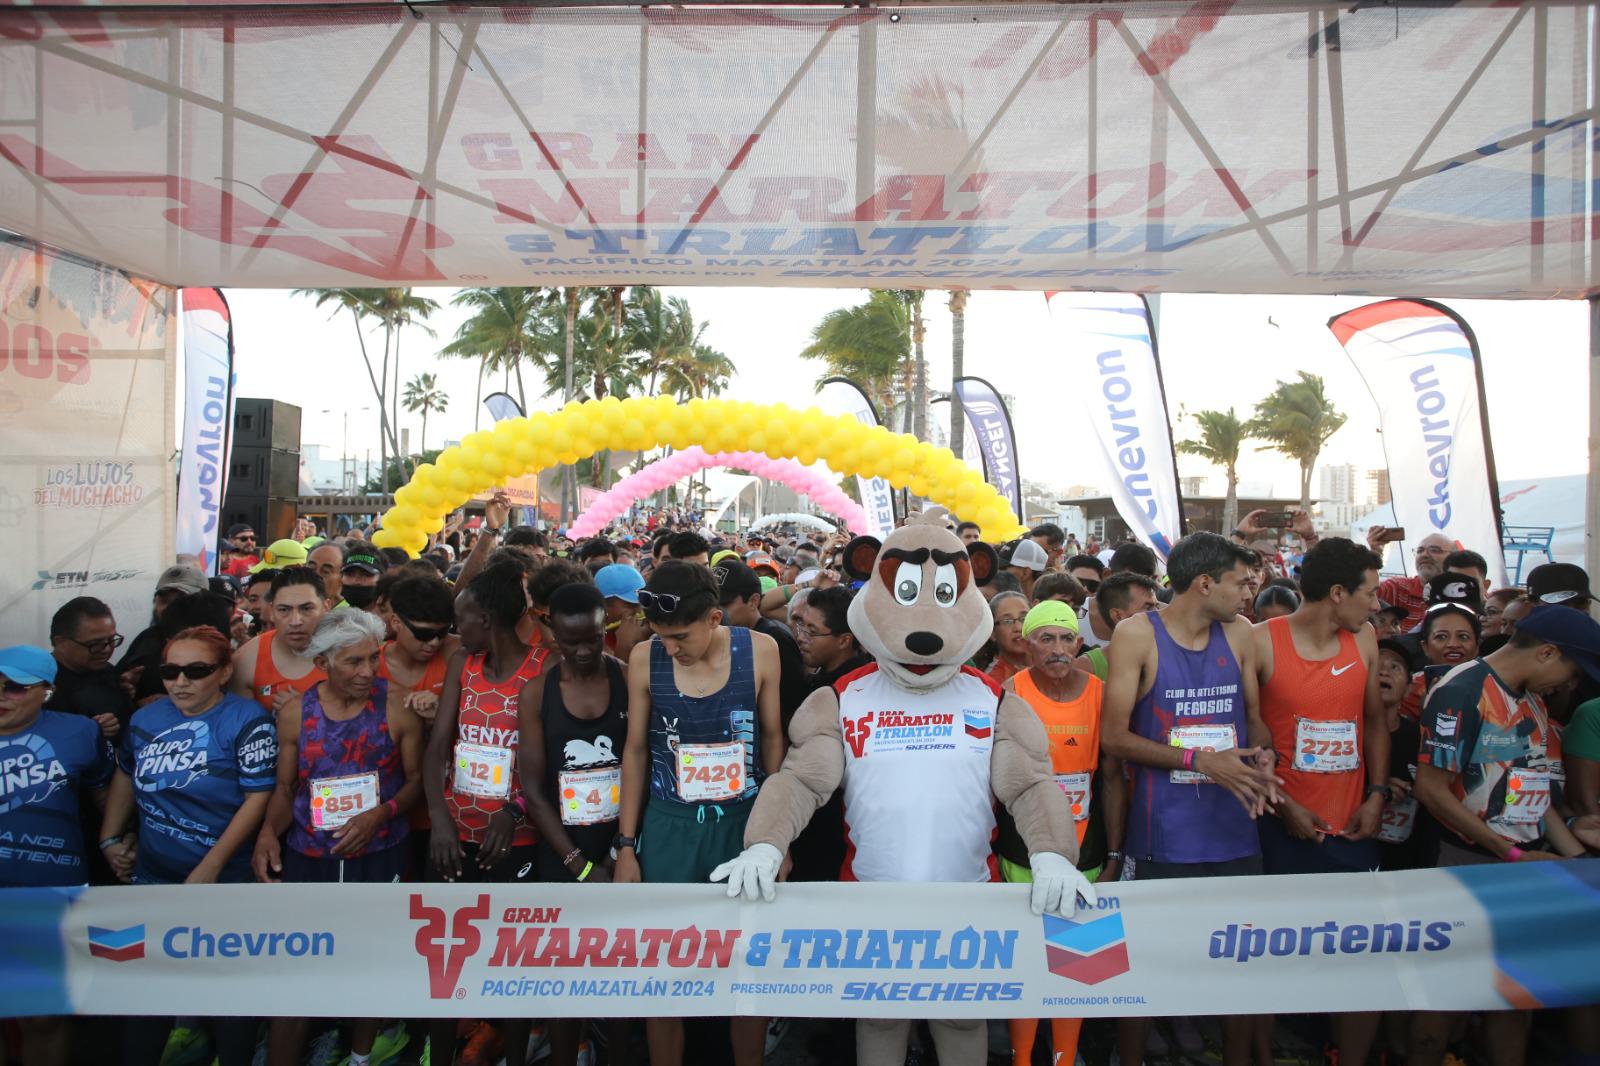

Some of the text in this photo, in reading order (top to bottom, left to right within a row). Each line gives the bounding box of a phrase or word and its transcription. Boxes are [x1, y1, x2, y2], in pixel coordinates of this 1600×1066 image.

[462, 132, 760, 171] GRAN
[522, 255, 692, 267] PACÍFICO
[927, 257, 1024, 267] 2024
[0, 319, 90, 385] OS
[1408, 364, 1452, 529] Chevron
[46, 461, 134, 486] LOS LUJOS
[33, 484, 144, 507] DEL MUCHACHO
[56, 571, 88, 584] ETN
[1165, 684, 1238, 698] CLUB DE ATLETISMO
[1175, 698, 1233, 716] PEGASOS
[459, 724, 519, 747] KENYA
[138, 739, 192, 759] GRUPO
[238, 736, 273, 757] GRUPO
[245, 746, 279, 766] PINS
[905, 743, 957, 751] SKECHERS
[1301, 738, 1354, 756] 2723
[0, 753, 34, 774] PO
[139, 750, 208, 777] PINSA
[470, 761, 489, 780] 12
[683, 762, 741, 784] 7420
[325, 793, 362, 813] 851
[586, 788, 602, 805] 4
[502, 907, 562, 923] GRAN
[162, 926, 335, 958] Chevron
[745, 932, 772, 967] &
[1208, 920, 1452, 963] dportenis
[481, 975, 715, 997] PACÍFICO MAZATLÁN 2024
[809, 983, 833, 995] POR
[841, 981, 1024, 1001] SKECHERS
[1042, 995, 1147, 1006] PATROCINADOR OFICIAL
